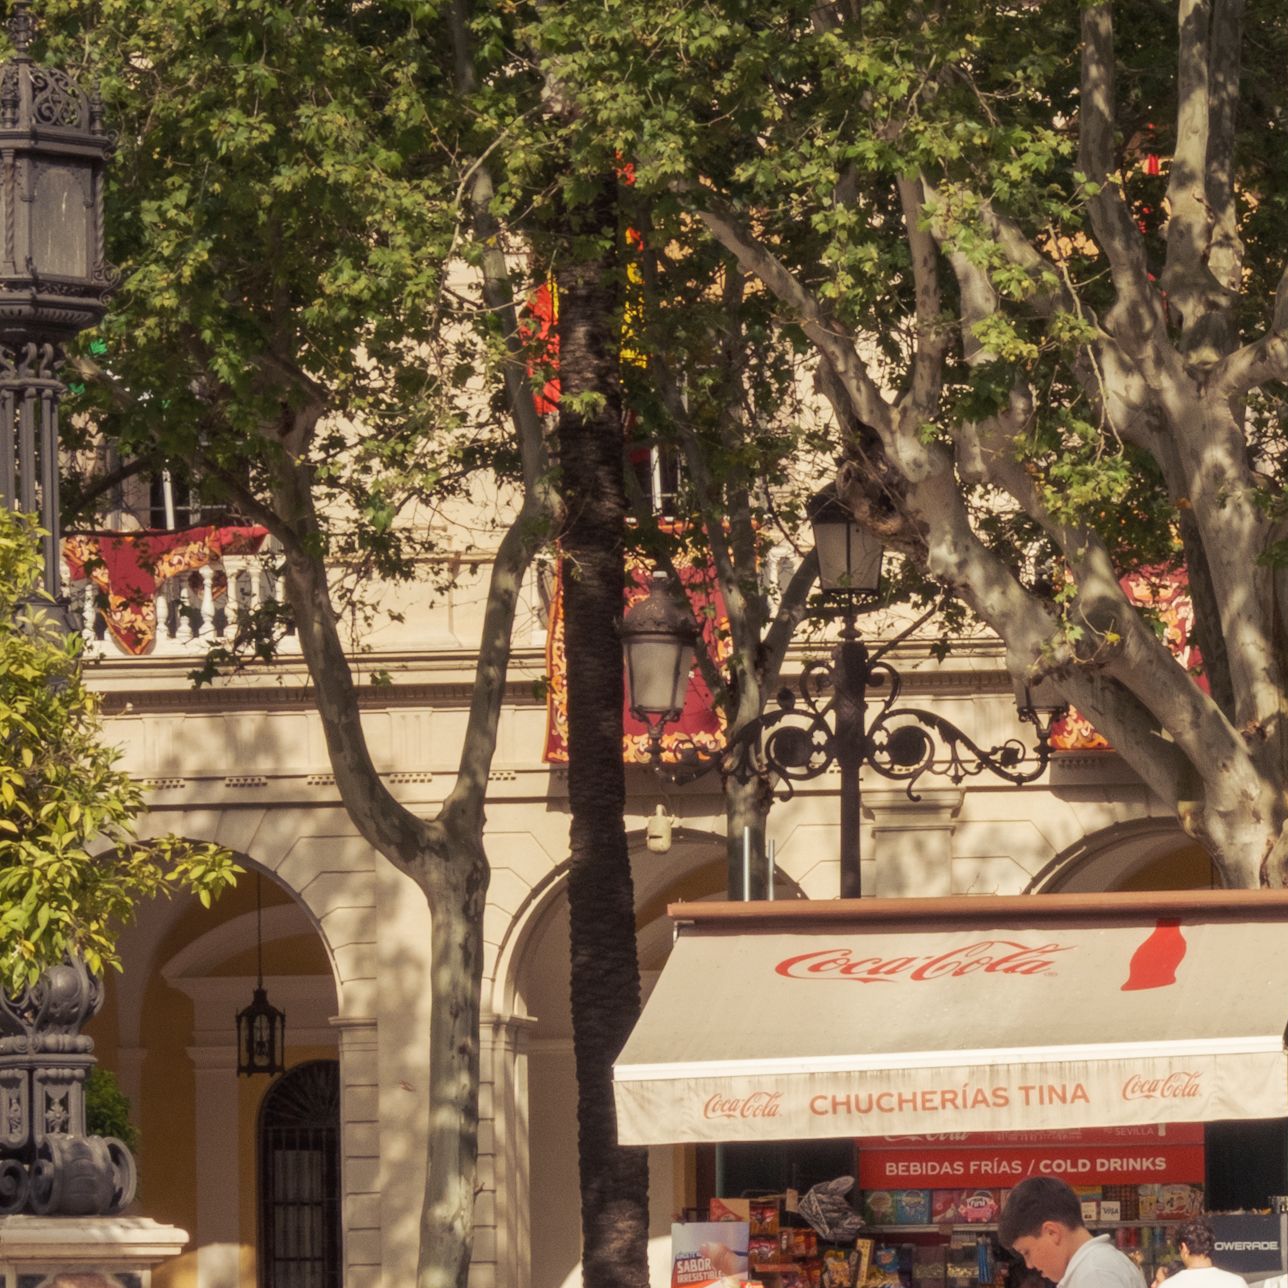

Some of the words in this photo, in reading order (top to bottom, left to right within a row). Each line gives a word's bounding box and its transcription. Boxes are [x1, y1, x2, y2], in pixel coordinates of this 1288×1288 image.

[775, 941, 1077, 983] Coca-Cola
[810, 1083, 1009, 1116] CHUCHERÍAS
[1018, 1083, 1090, 1107] TINA
[1122, 1071, 1204, 1101] Coca-Cola
[703, 1091, 783, 1120] Coca-Cola
[885, 1161, 964, 1176] BEBIDAS
[969, 1158, 1023, 1174] FRÍAS
[1027, 1159, 1035, 1175] /
[1039, 1158, 1091, 1173] COLD
[1096, 1156, 1167, 1172] DRINKS
[1214, 1241, 1279, 1251] OWERADE
[677, 1257, 712, 1274] SABOR
